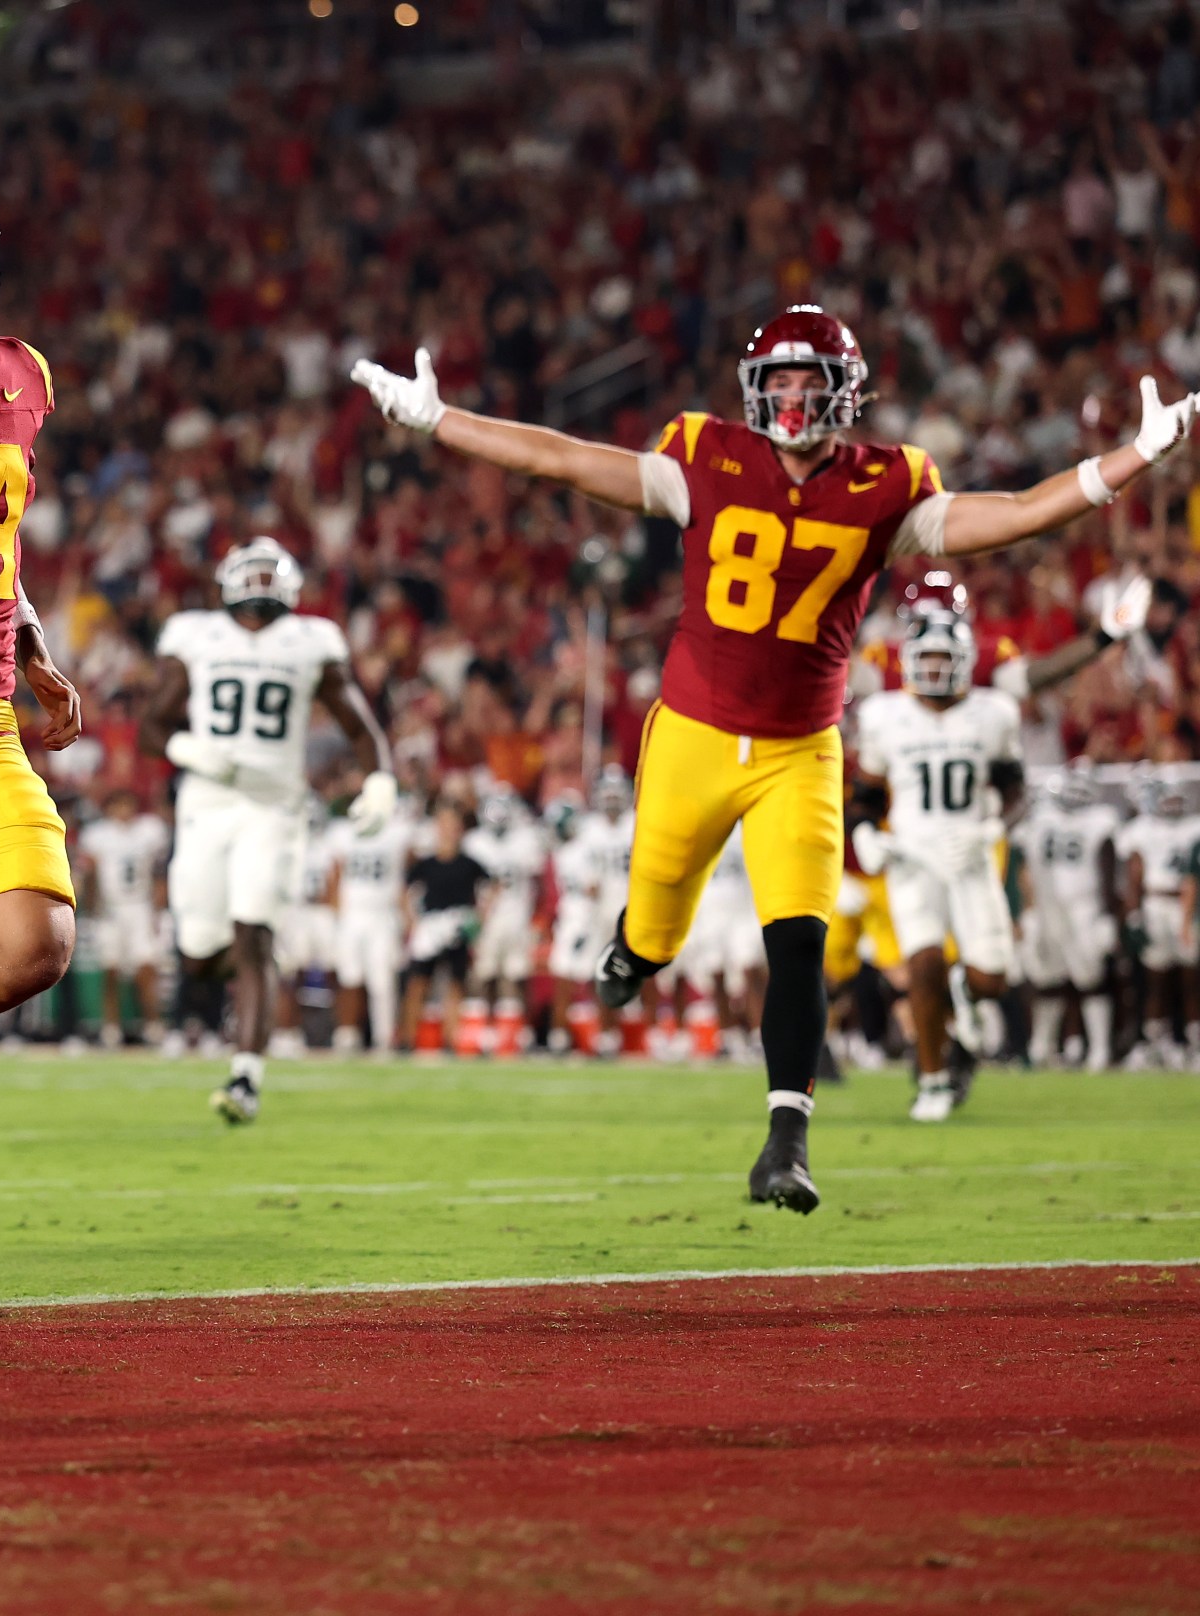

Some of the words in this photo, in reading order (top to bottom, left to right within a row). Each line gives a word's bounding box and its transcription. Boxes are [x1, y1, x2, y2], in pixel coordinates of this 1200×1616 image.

[705, 505, 870, 644] 87
[210, 678, 293, 740] 99
[915, 759, 975, 812] 10
